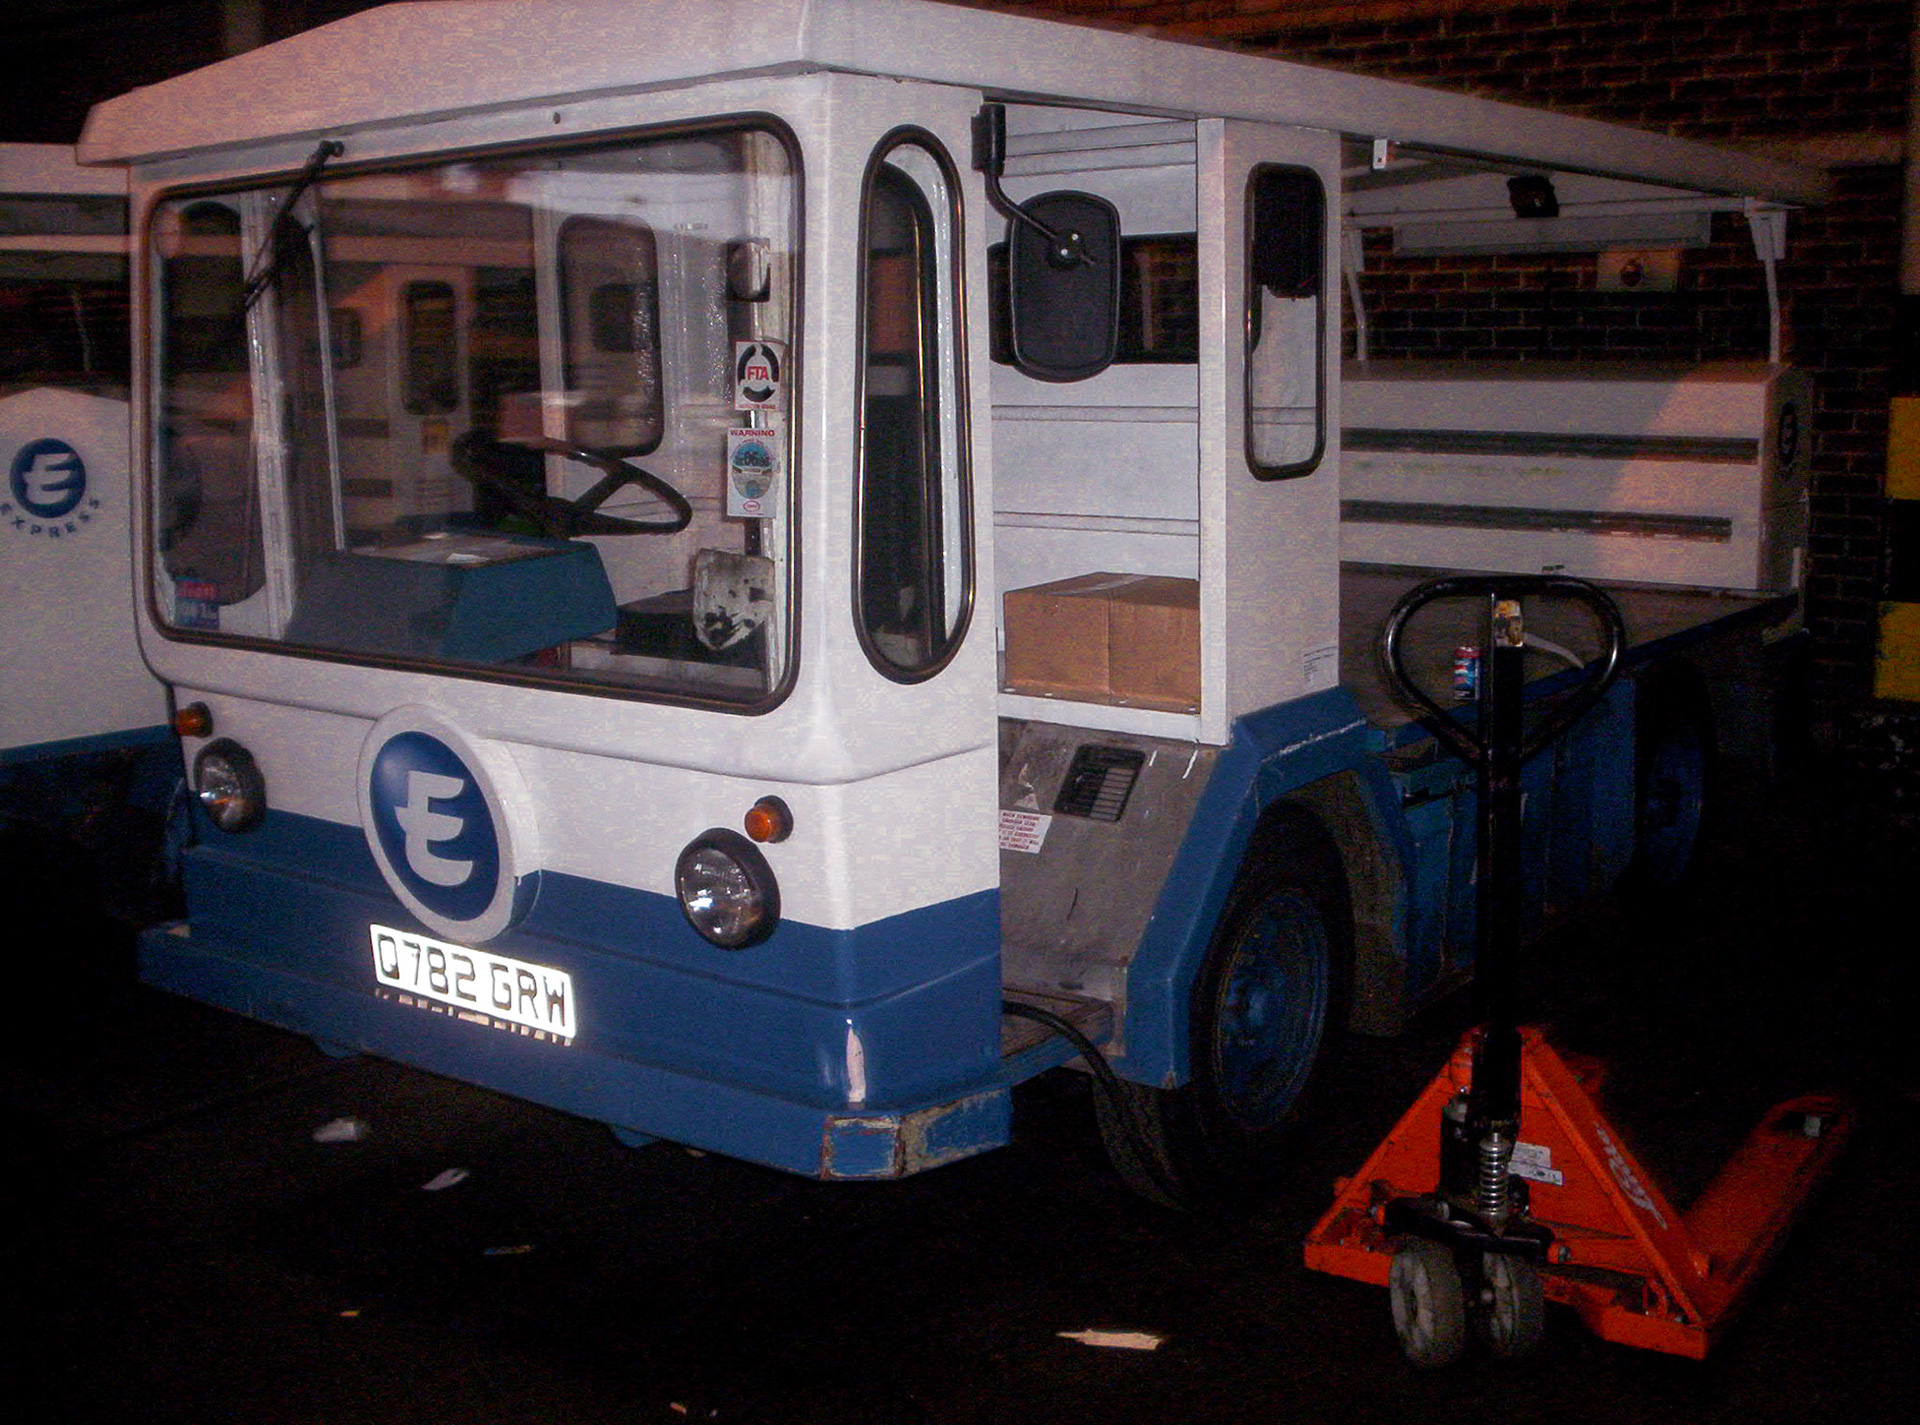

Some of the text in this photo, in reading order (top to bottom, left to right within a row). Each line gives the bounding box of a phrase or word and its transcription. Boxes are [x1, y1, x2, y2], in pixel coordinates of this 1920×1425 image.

[747, 365, 769, 381] FTA
[730, 429, 775, 437] WARNING
[489, 961, 566, 1027] GRW
